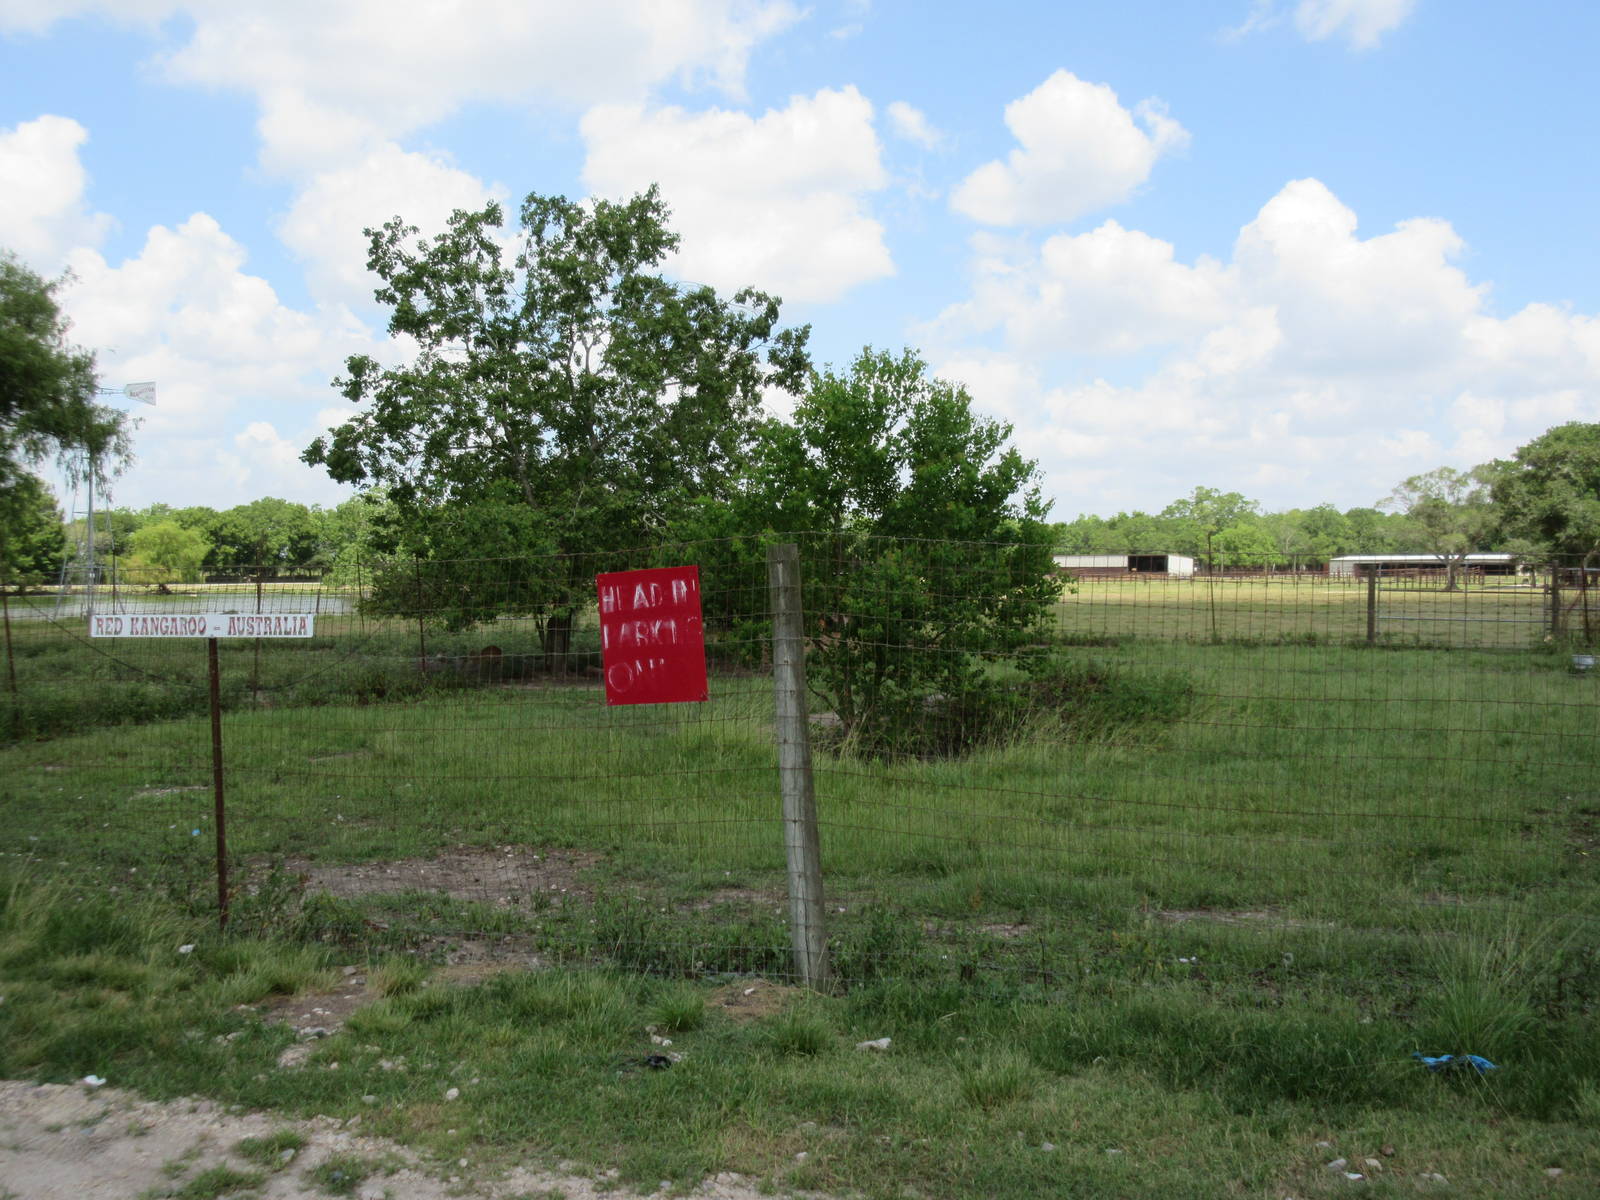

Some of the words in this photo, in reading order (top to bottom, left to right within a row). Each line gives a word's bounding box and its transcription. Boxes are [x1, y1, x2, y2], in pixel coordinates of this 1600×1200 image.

[95, 617, 123, 635] RED
[130, 616, 208, 635] KANGAROO
[228, 616, 308, 635] AUSTRALIA
